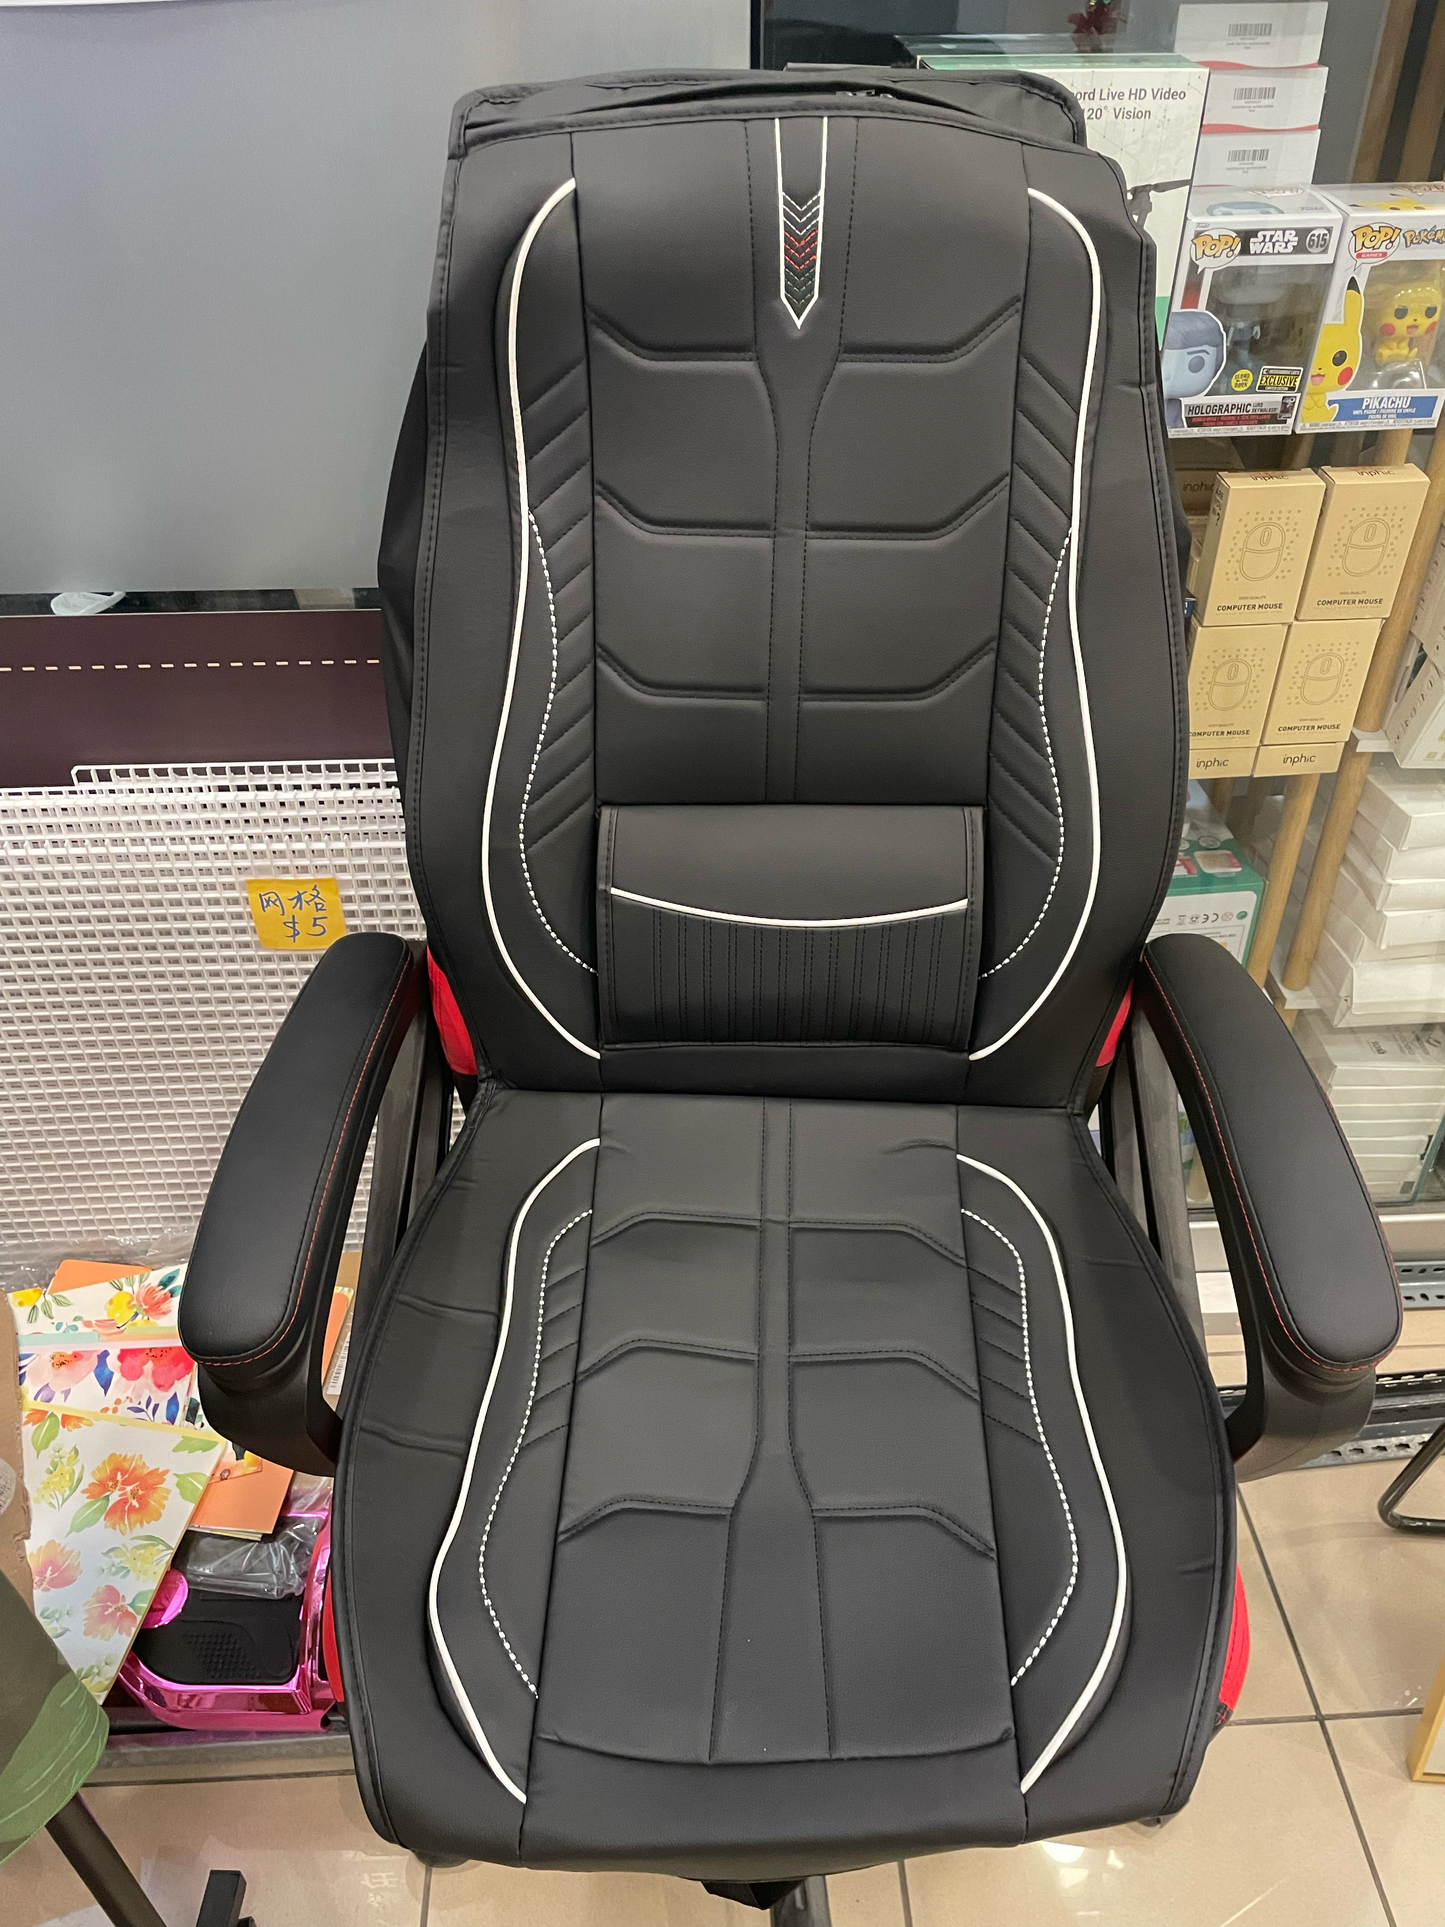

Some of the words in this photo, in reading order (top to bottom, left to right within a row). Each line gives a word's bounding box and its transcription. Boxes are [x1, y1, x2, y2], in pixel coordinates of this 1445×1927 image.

[1075, 87, 1096, 101] ord
[1099, 87, 1125, 101] Live
[1128, 88, 1147, 101] HD
[1151, 87, 1187, 101] Video
[1113, 107, 1152, 120] Vision
[1251, 229, 1298, 242] STAR
[1307, 233, 1328, 249] 615
[1351, 224, 1402, 253] POP!
[1190, 233, 1241, 261] POP!
[1249, 241, 1298, 254] WARS
[1260, 375, 1299, 387] EXCLUSIVE
[1187, 402, 1252, 416] HOLOGRAPHIC
[1362, 396, 1412, 410] PIKACHU
[1217, 603, 1256, 612] COMPUTER
[1258, 602, 1283, 610] MOUSE
[1317, 598, 1357, 606] COMPUTER
[1278, 723, 1316, 732] COMPUTER
[1317, 722, 1342, 730] MOUSE
[1196, 757, 1230, 770] inphic
[1283, 753, 1317, 766] inphic
[259, 884, 328, 917] 网格
[283, 914, 329, 944] $5
